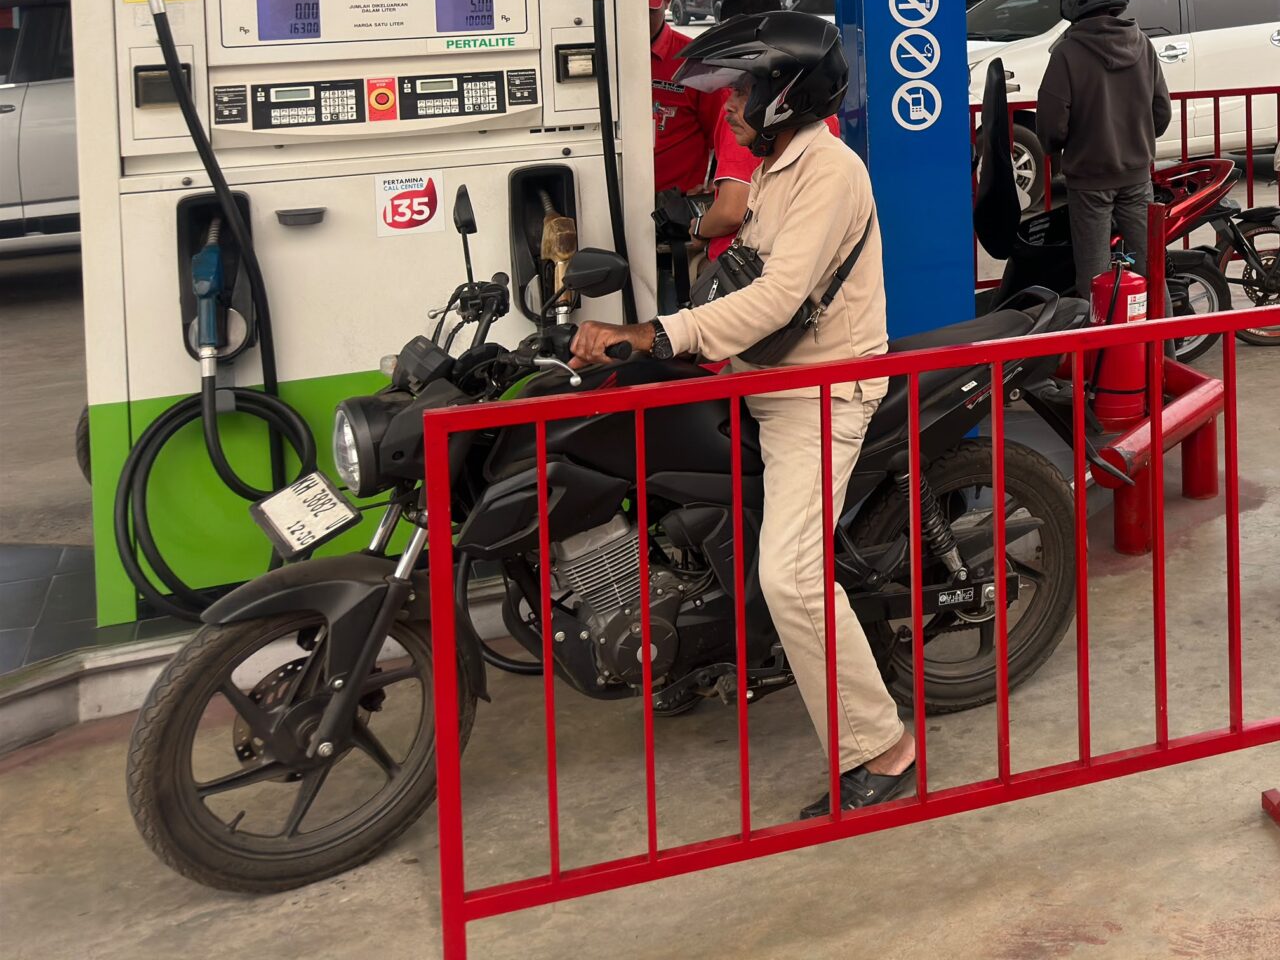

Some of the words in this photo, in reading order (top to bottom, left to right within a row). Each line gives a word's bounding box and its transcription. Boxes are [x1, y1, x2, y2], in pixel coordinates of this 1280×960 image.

[501, 15, 511, 23] Rp
[239, 26, 250, 35] Rp
[446, 37, 515, 49] PERTALITE
[383, 177, 424, 185] PERTAMINA
[385, 196, 431, 224] 135
[290, 475, 319, 497] KH
[302, 488, 337, 518] 3882
